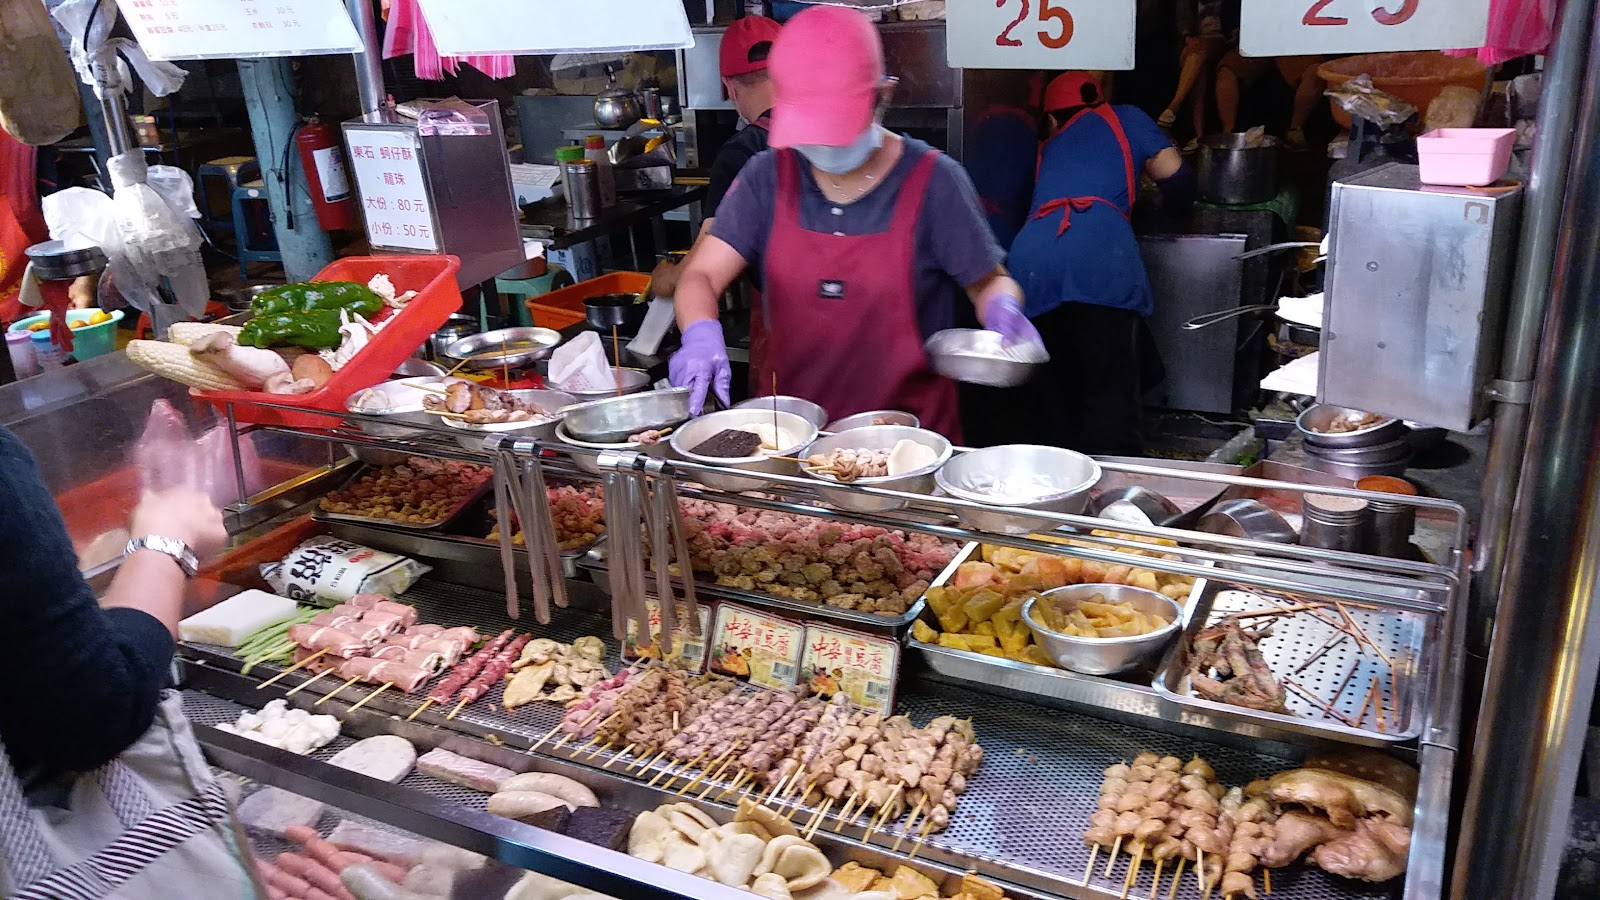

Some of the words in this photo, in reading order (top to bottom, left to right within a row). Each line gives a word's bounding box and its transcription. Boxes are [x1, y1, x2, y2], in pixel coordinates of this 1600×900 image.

[996, 0, 1075, 49] 25
[352, 145, 375, 159] 東石
[760, 629, 791, 657] 豆腐
[852, 648, 883, 675] 豆腐
